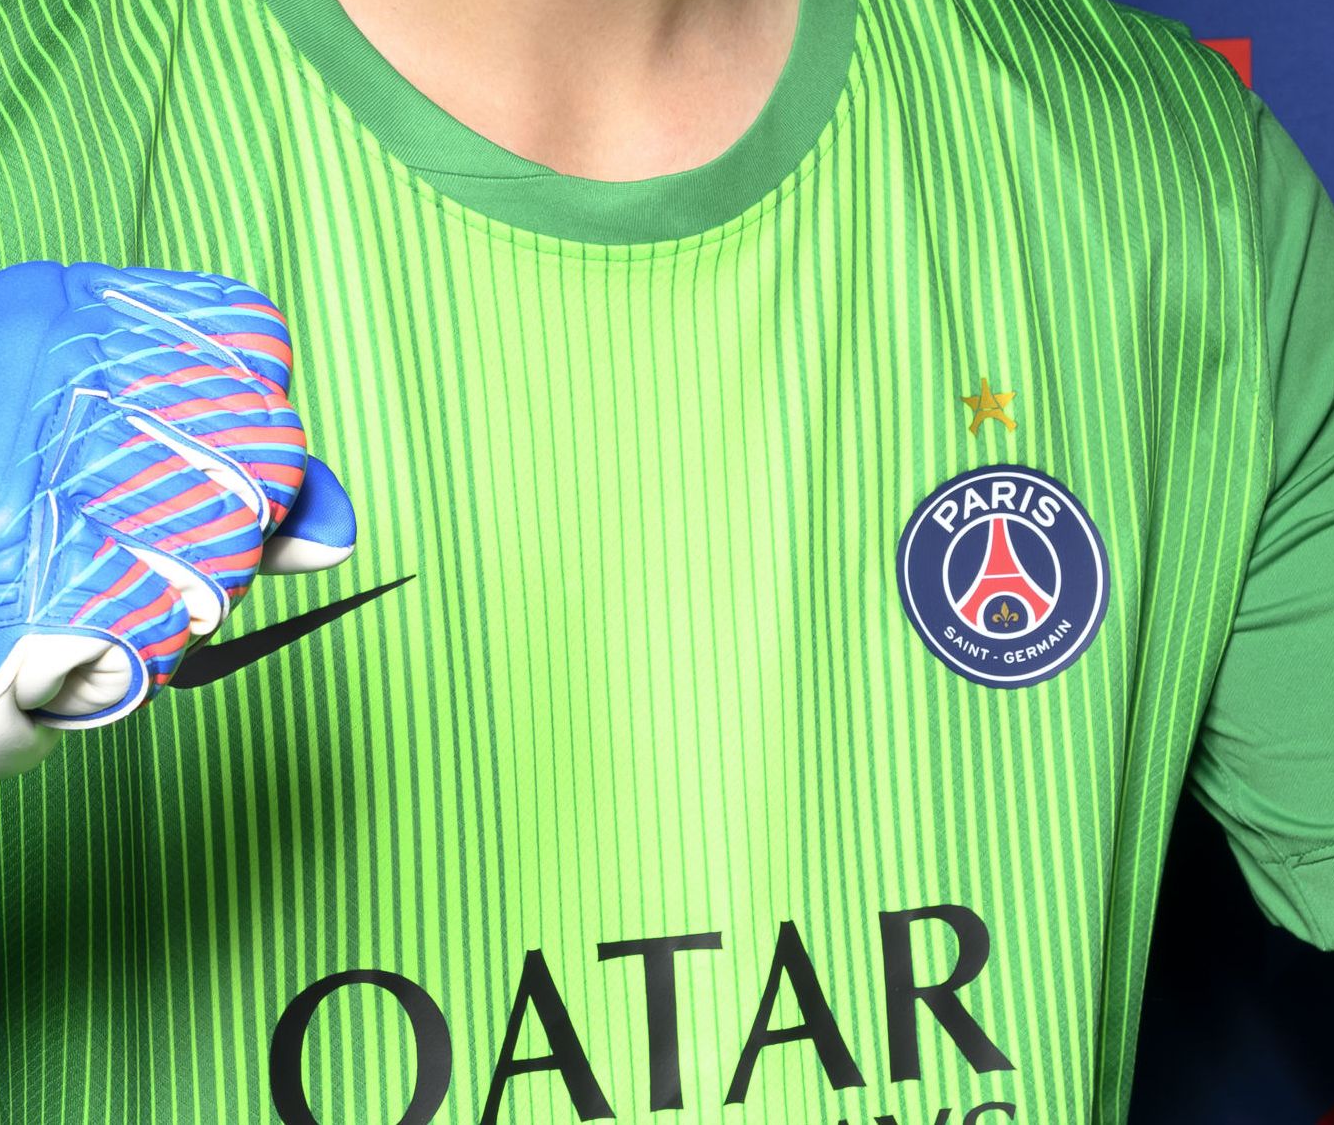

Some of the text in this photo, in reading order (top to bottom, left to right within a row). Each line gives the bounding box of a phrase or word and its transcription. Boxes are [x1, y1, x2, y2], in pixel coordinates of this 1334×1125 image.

[932, 481, 1061, 534] PARIS
[943, 625, 990, 661] SAINT
[1003, 619, 1072, 664] GERMAIN
[268, 902, 1017, 1125] QATAR
